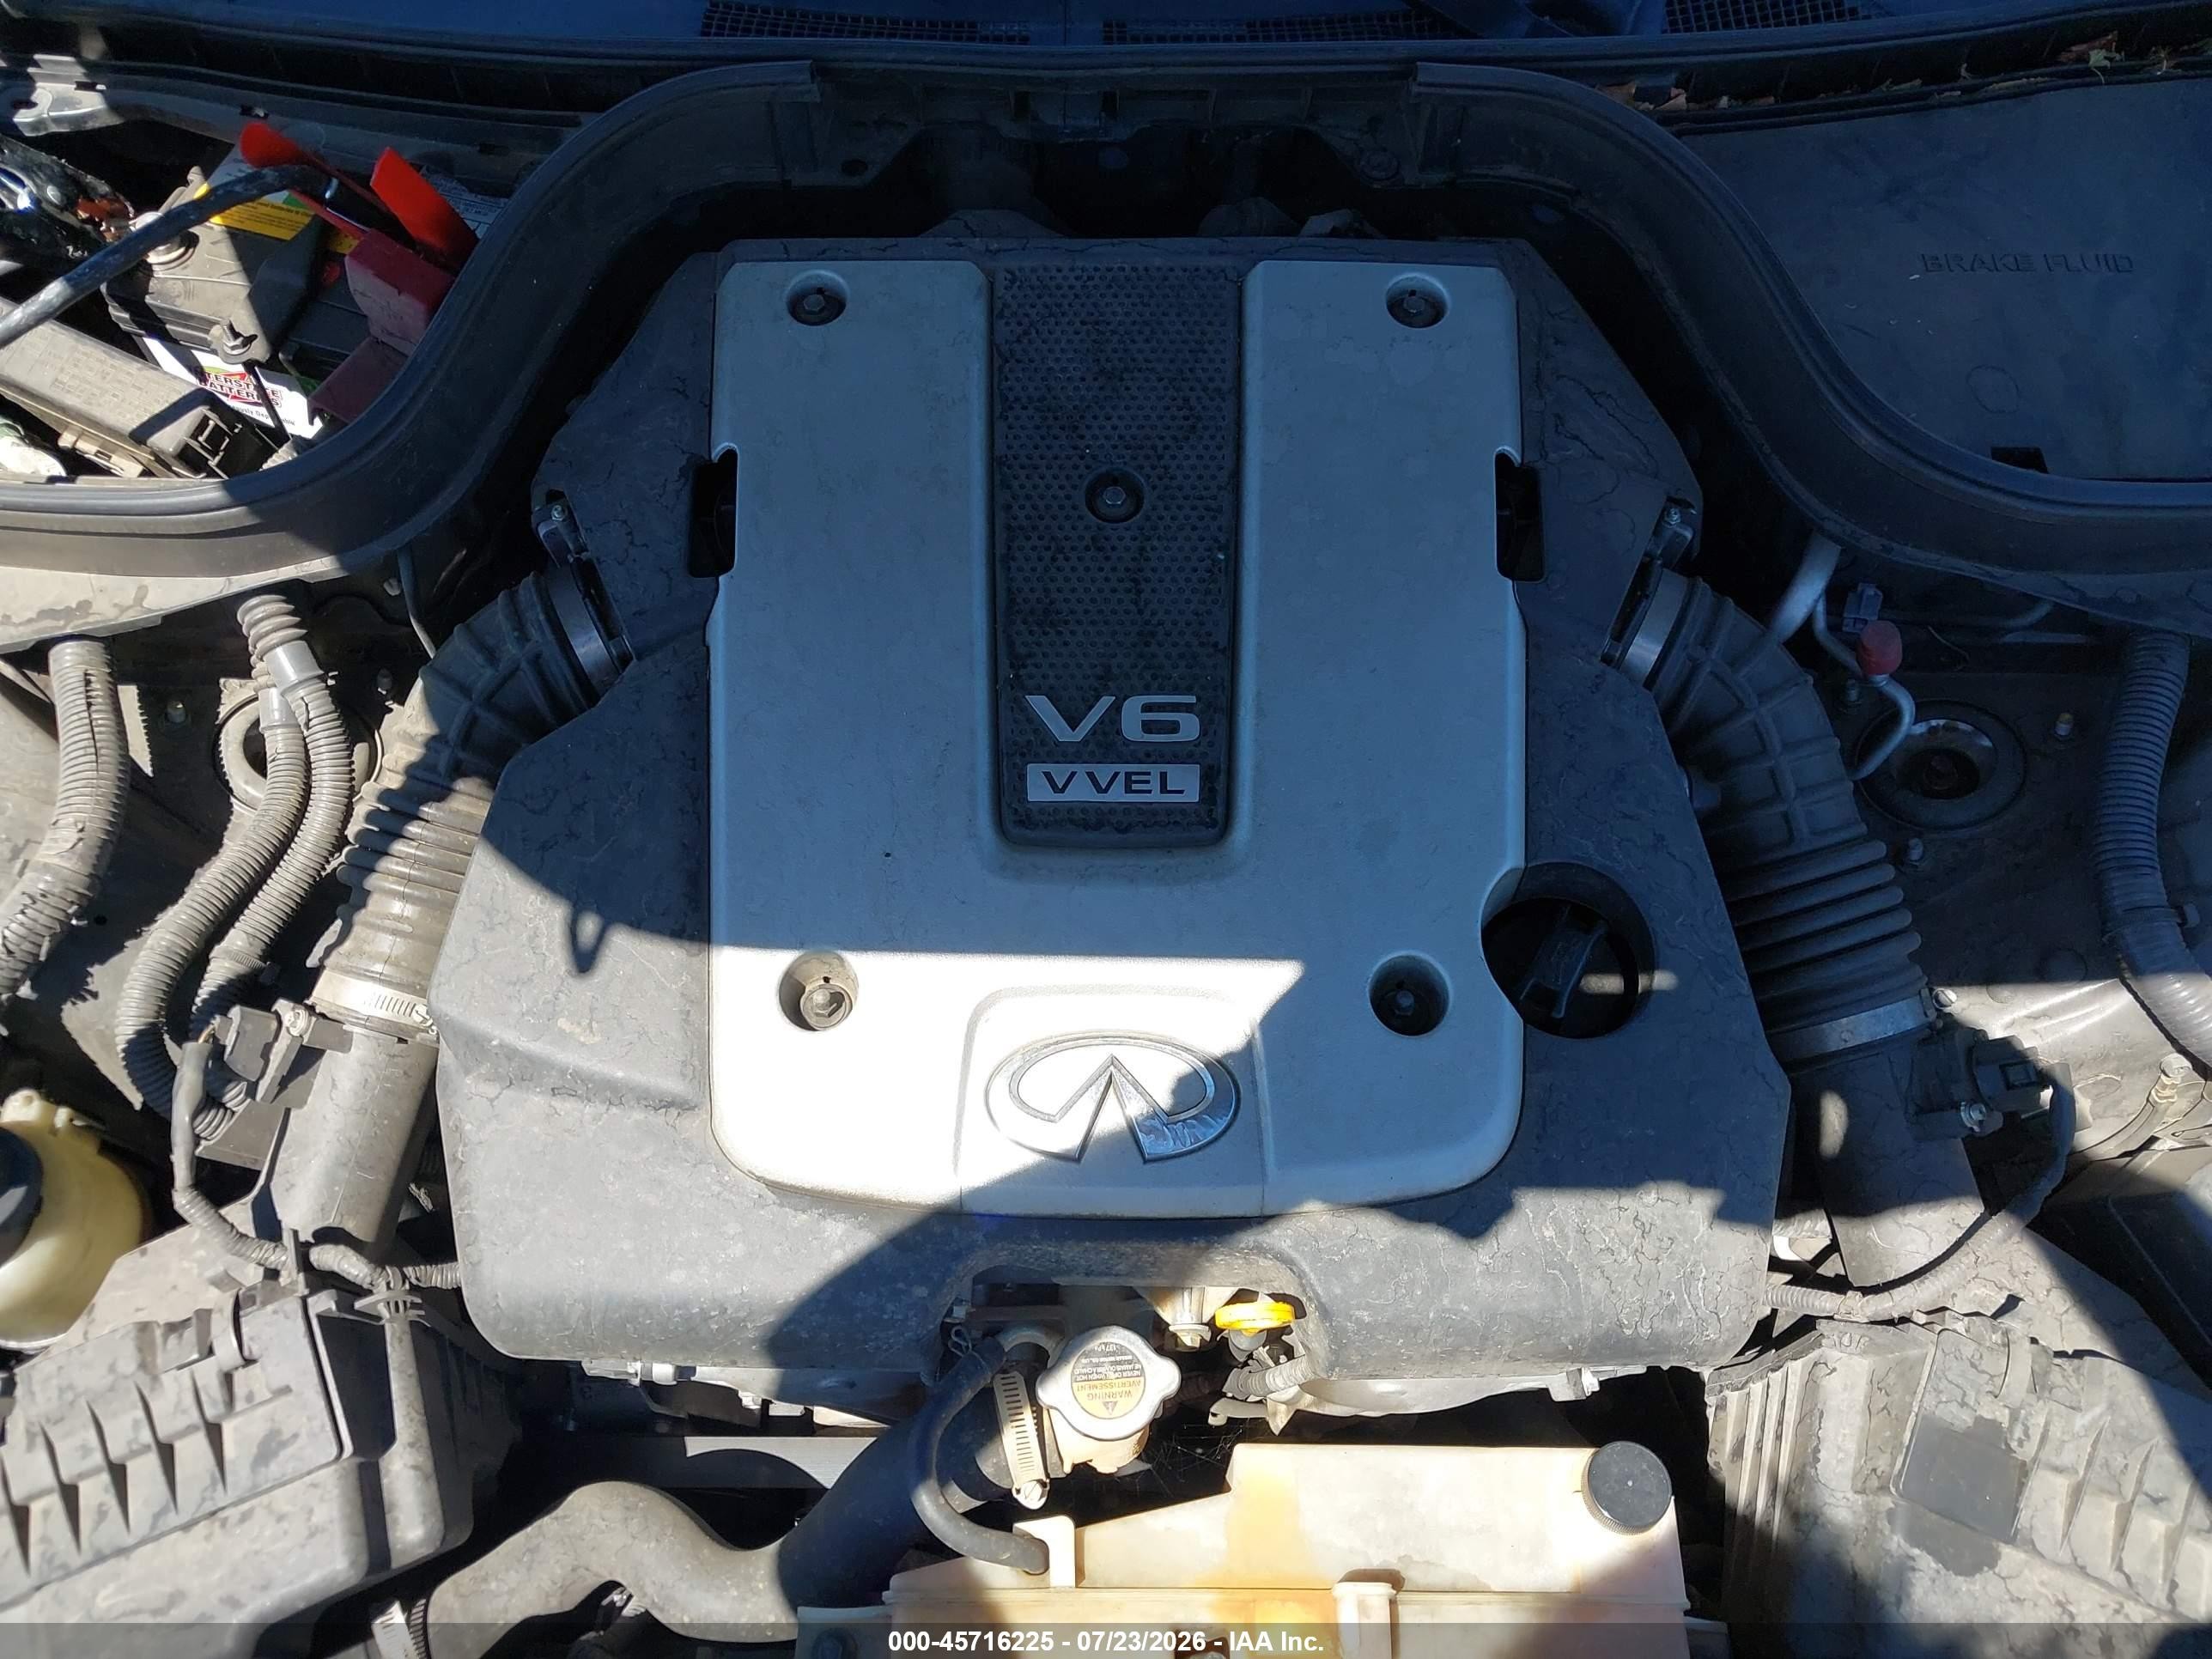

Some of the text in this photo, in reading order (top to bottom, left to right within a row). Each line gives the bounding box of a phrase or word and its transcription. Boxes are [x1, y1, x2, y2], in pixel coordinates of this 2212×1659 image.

[1921, 252, 2135, 273] BRAKE FLUID
[1024, 695, 1200, 742] V6
[1042, 771, 1186, 794] VVEL
[1077, 1379, 1141, 1392] AVERTISSEMENT
[1086, 1389, 1133, 1401] WARNING
